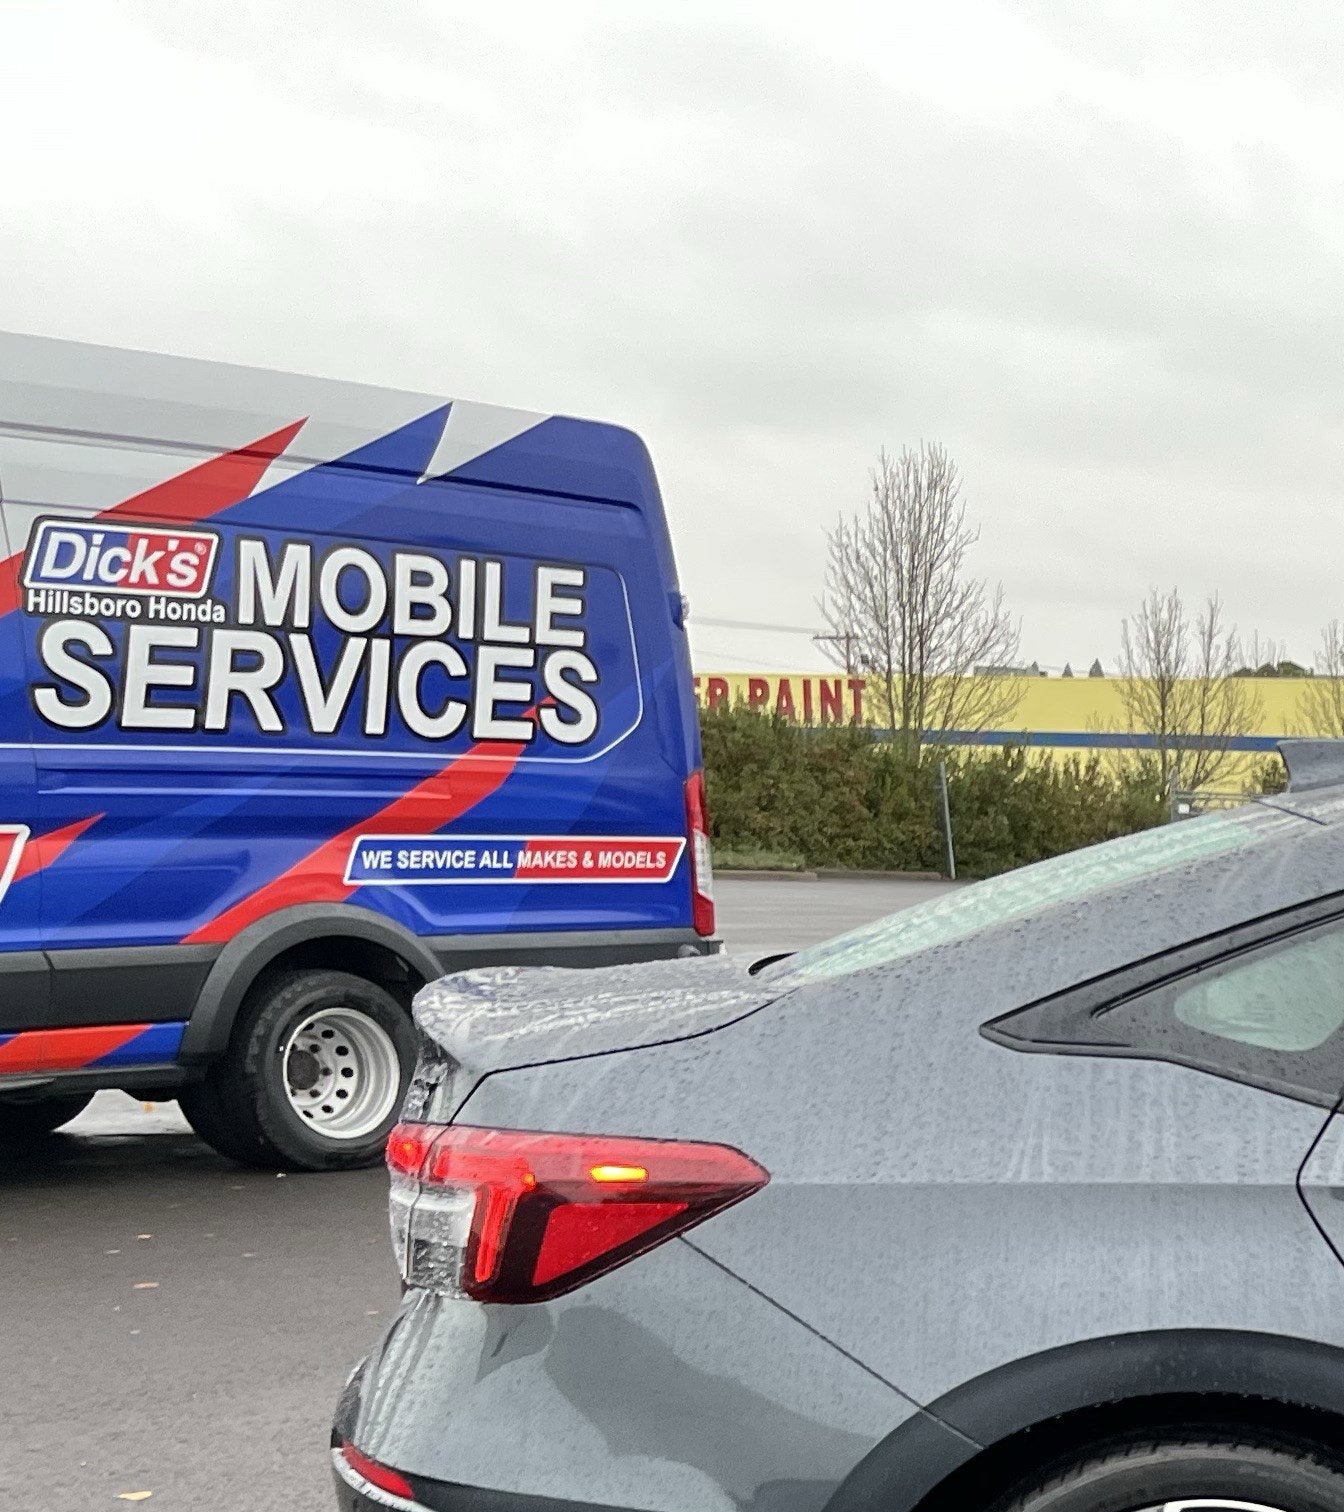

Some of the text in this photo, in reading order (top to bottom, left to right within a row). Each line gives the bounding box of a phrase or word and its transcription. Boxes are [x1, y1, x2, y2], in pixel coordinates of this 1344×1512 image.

[39, 531, 200, 588] Dick's
[27, 589, 226, 623] Hillsboro Honda
[238, 540, 585, 647] MOBILE
[34, 619, 598, 743] SERVICES
[748, 677, 867, 725] PAINT
[361, 850, 667, 870] WE SERVICE ALL MAKES & MODELS
